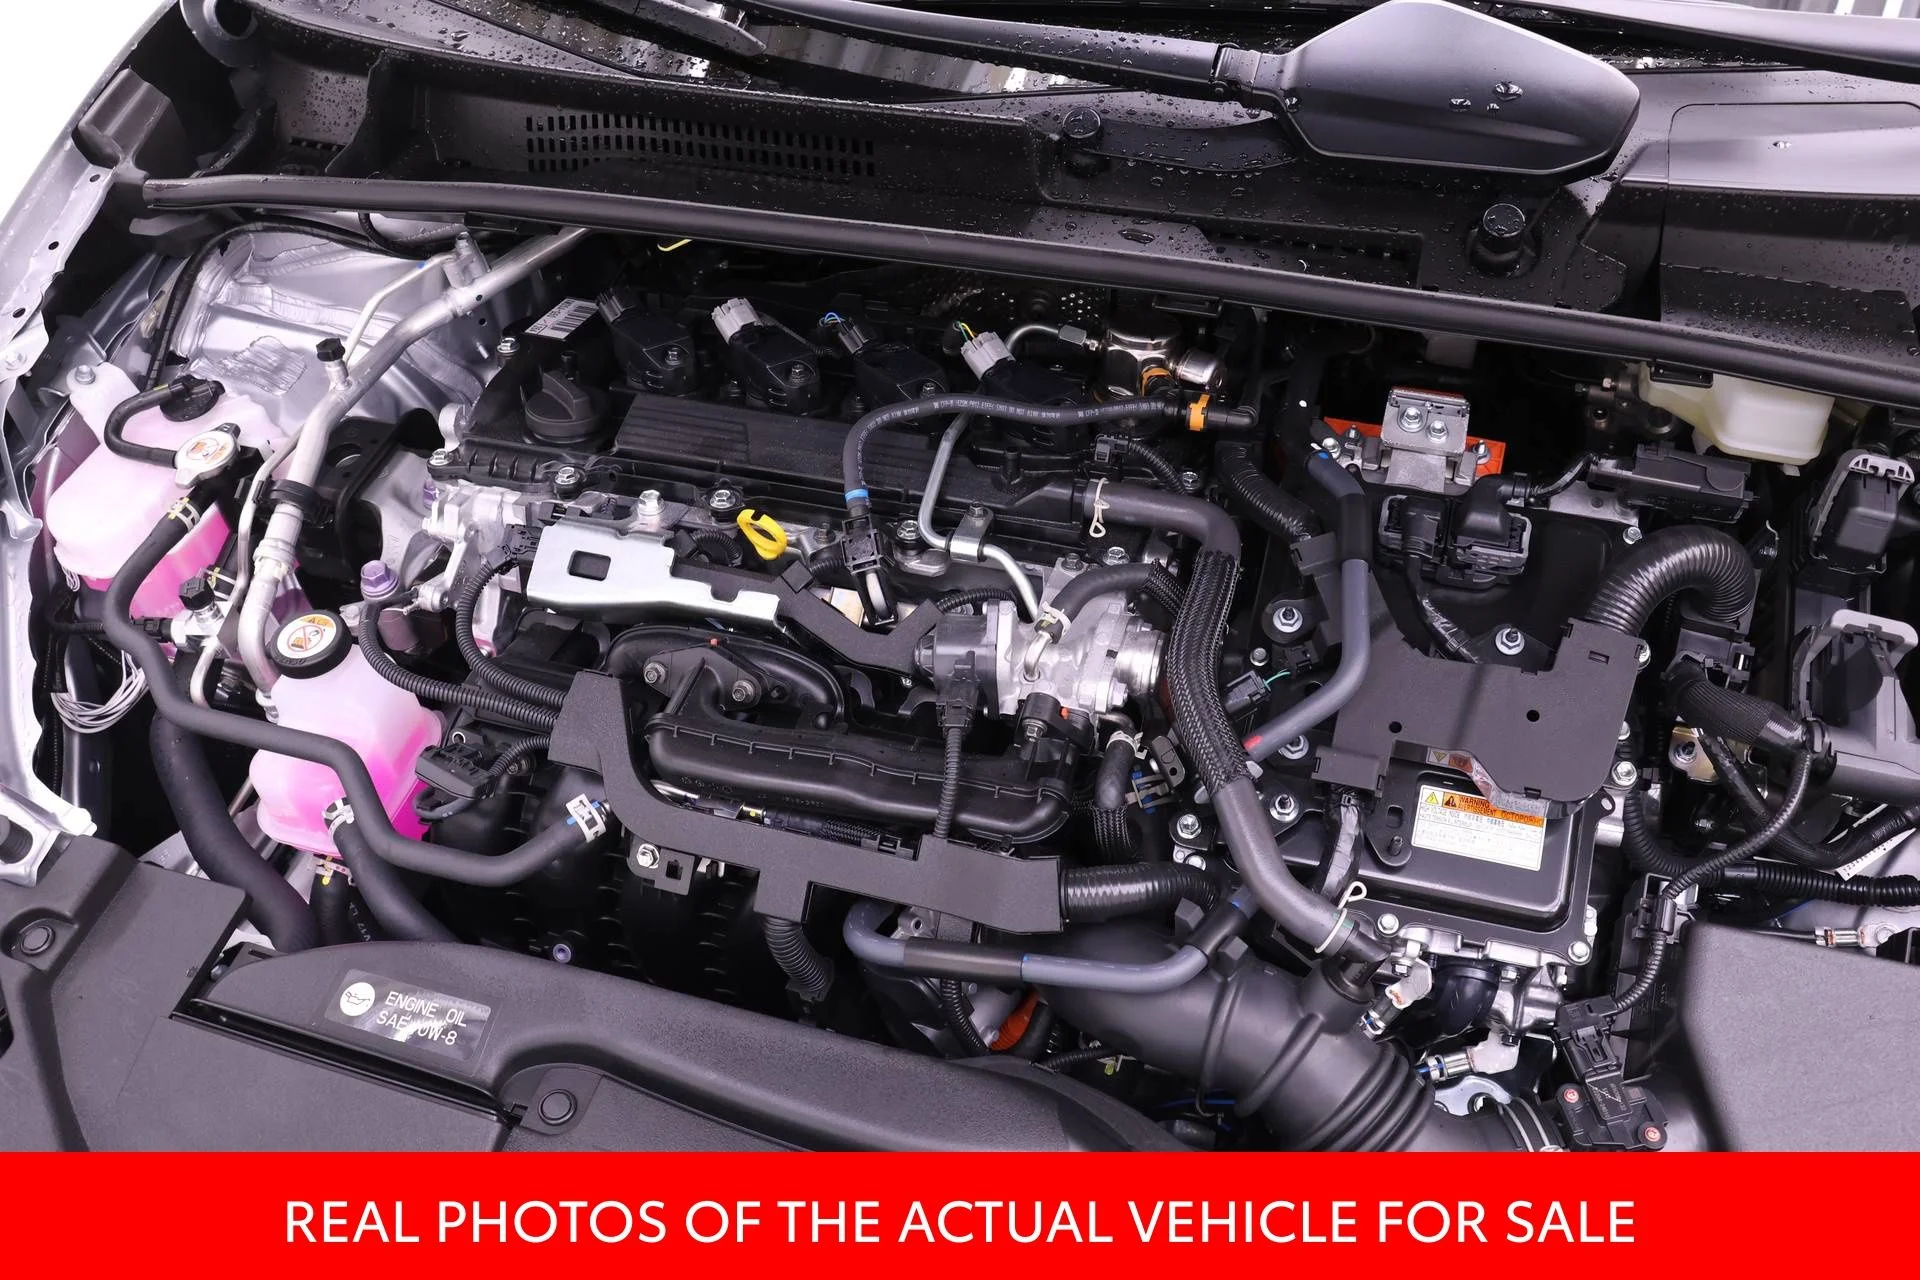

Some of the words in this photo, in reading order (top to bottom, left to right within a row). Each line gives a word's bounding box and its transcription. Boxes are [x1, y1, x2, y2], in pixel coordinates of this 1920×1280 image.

[1460, 795, 1490, 809] WARNING
[385, 990, 440, 1018] ENGINE
[445, 1008, 467, 1028] OIL
[376, 1010, 412, 1031] SAE
